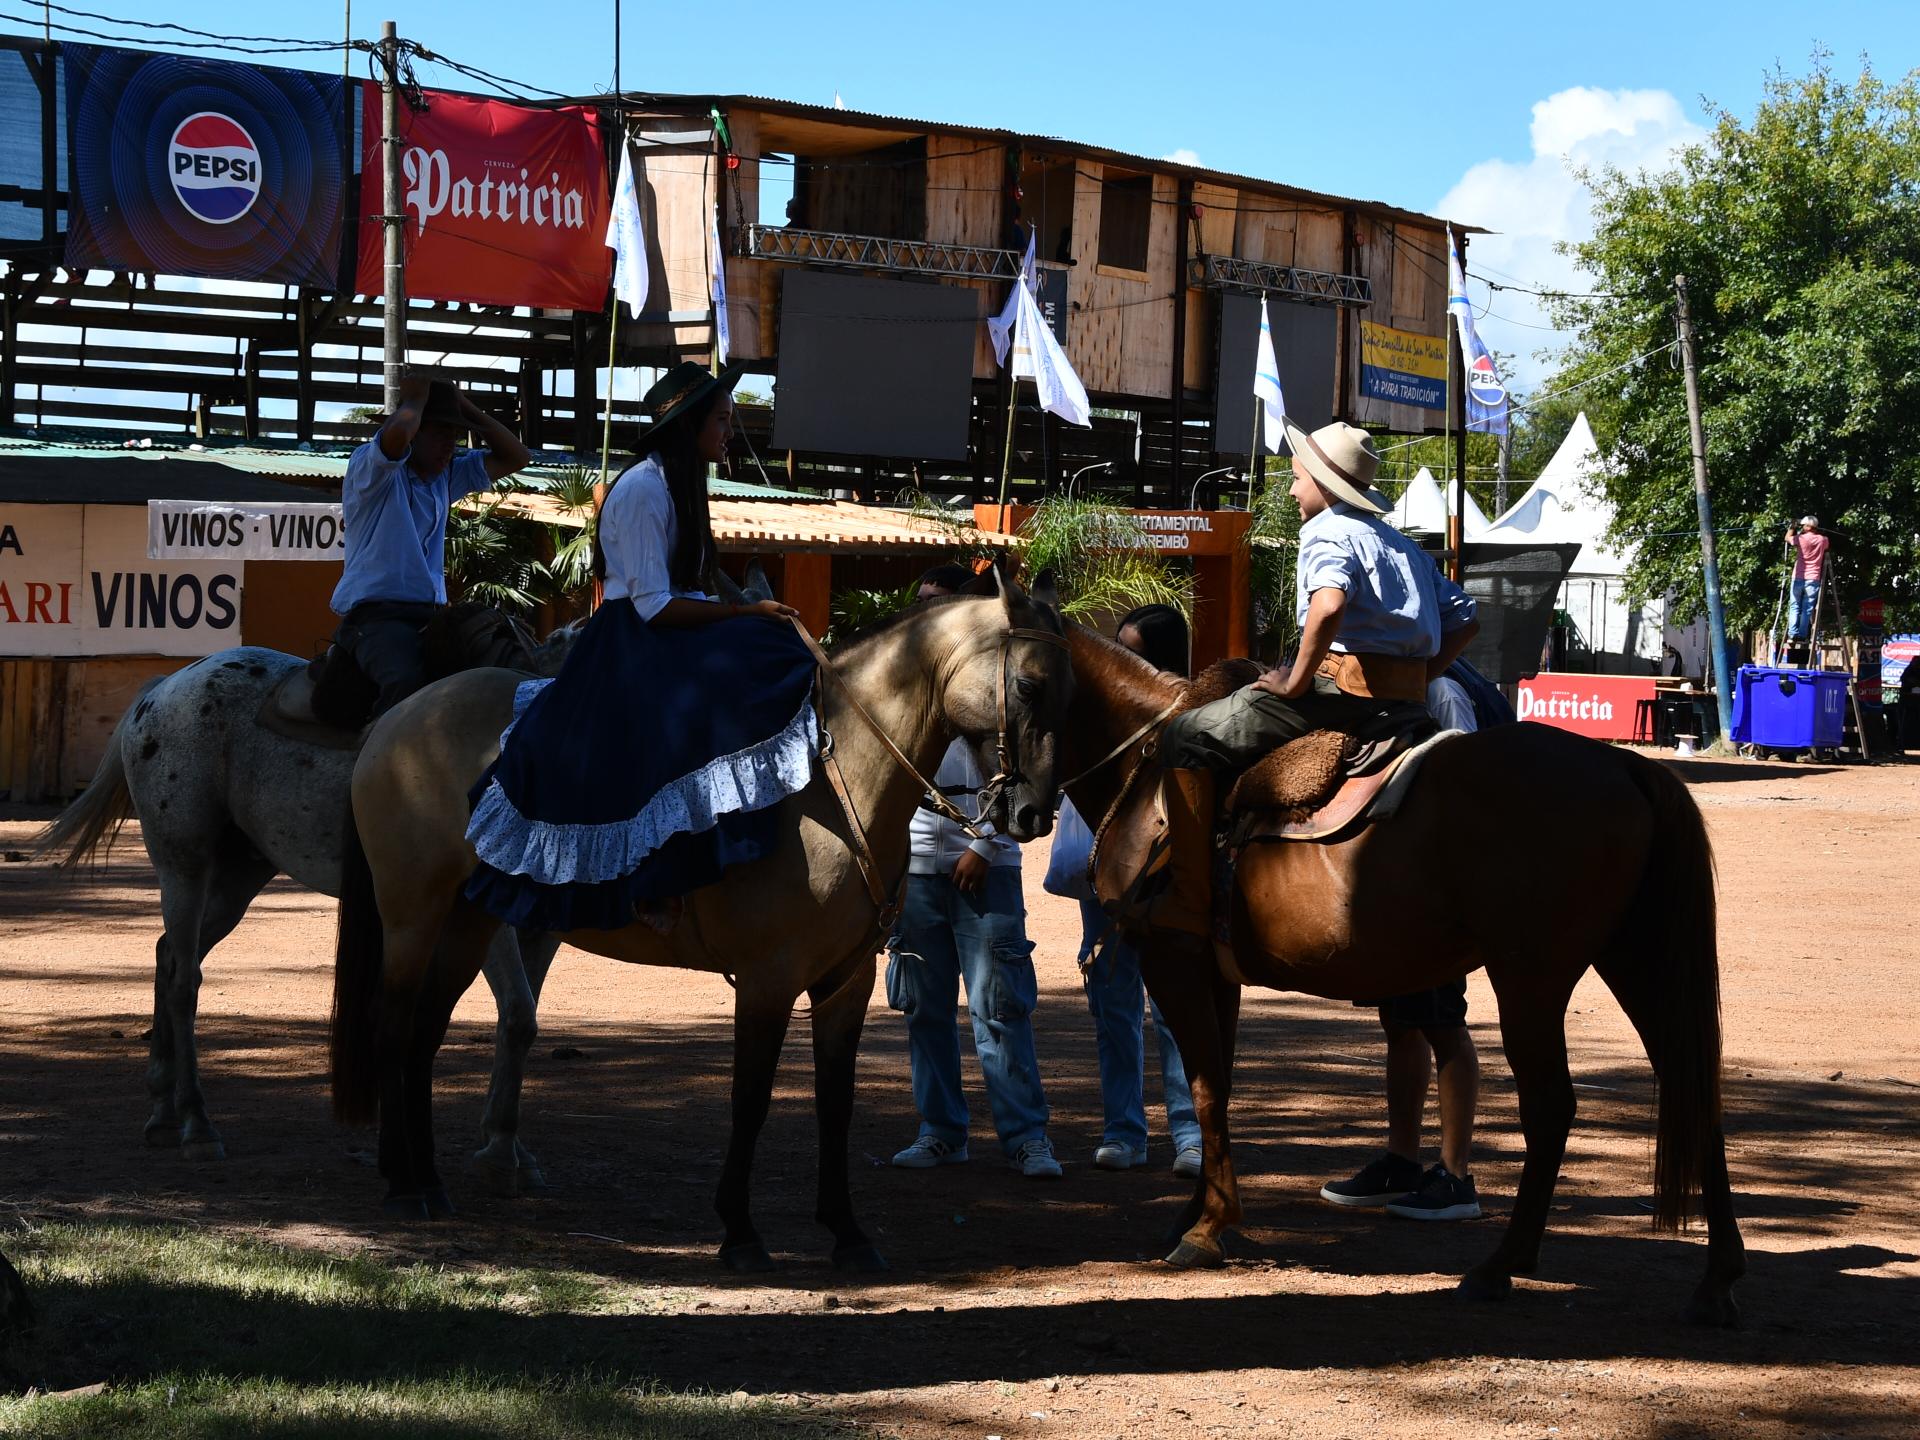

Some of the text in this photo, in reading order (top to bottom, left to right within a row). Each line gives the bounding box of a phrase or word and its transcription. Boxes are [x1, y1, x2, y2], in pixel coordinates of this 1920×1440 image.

[174, 151, 256, 183] PEPSI
[484, 160, 515, 169] CERVEZA
[402, 147, 585, 238] Patricia
[1044, 302, 1056, 325] FM
[1380, 380, 1399, 397] PURA
[162, 513, 245, 547] VINOS
[91, 571, 237, 630] VINOS
